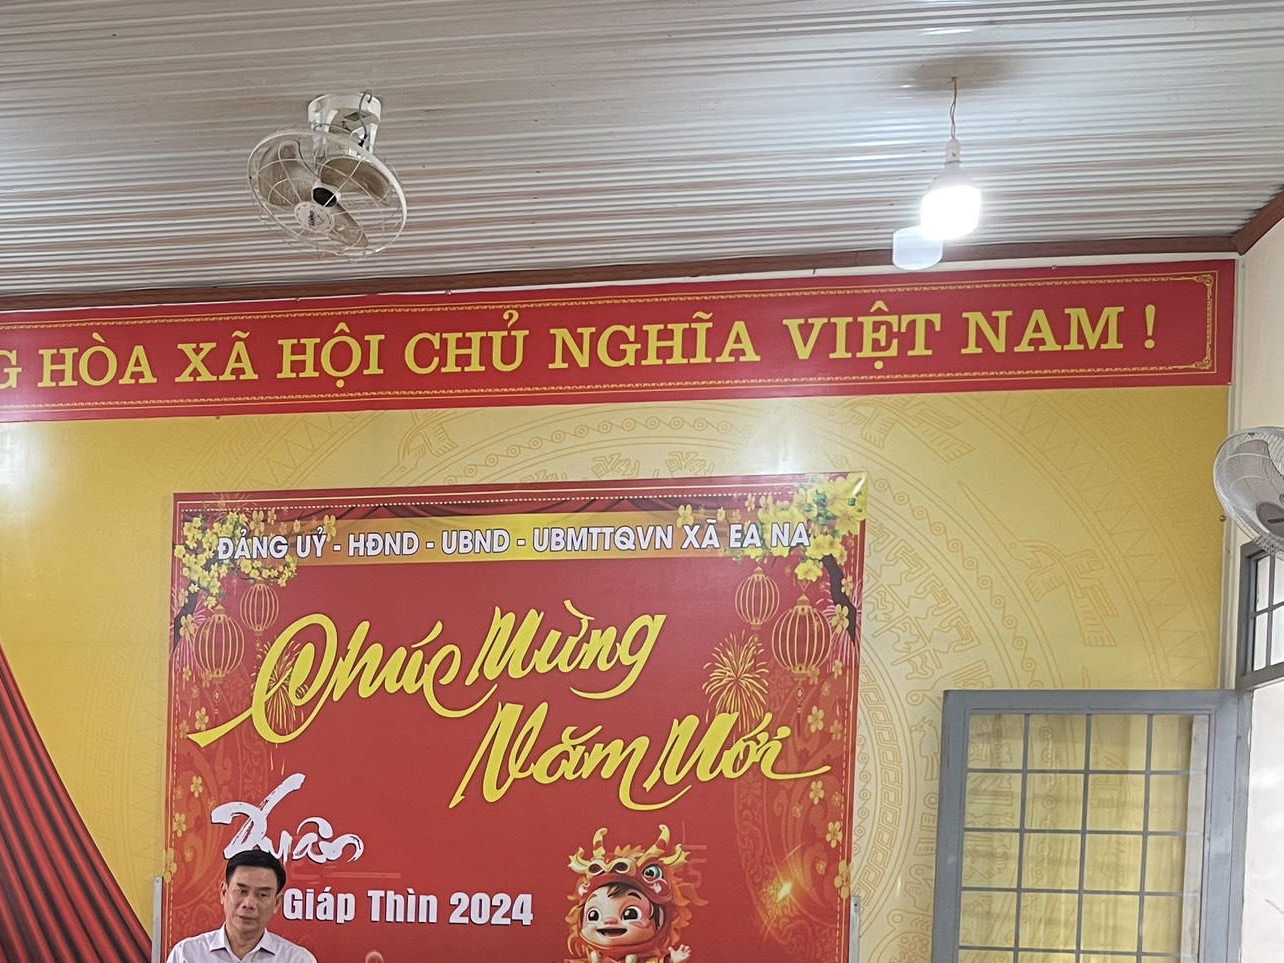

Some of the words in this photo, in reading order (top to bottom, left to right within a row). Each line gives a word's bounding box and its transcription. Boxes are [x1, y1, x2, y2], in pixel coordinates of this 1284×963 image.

[37, 332, 158, 388] HÒA
[175, 330, 259, 383] XÃ
[277, 323, 385, 388] HỘI
[405, 310, 530, 375] CHỦ
[548, 311, 762, 369] NGHĨA
[782, 300, 942, 370] VIỆT
[960, 307, 1125, 354] NAM
[217, 529, 289, 560] ĐẢNG
[348, 532, 419, 557] HĐND
[441, 529, 511, 554] UBND
[533, 525, 673, 551] UBMTTQVN
[682, 519, 720, 549] XÃ
[729, 523, 762, 548] EA
[771, 522, 810, 547] NA
[188, 613, 498, 748] Chúc
[465, 600, 666, 699] Mừng
[449, 701, 692, 811] Năm
[644, 708, 831, 793] Mới
[211, 773, 365, 864] Xuân
[283, 886, 357, 924] Giáp
[367, 886, 438, 924] Thìn
[449, 891, 534, 927] 2024
